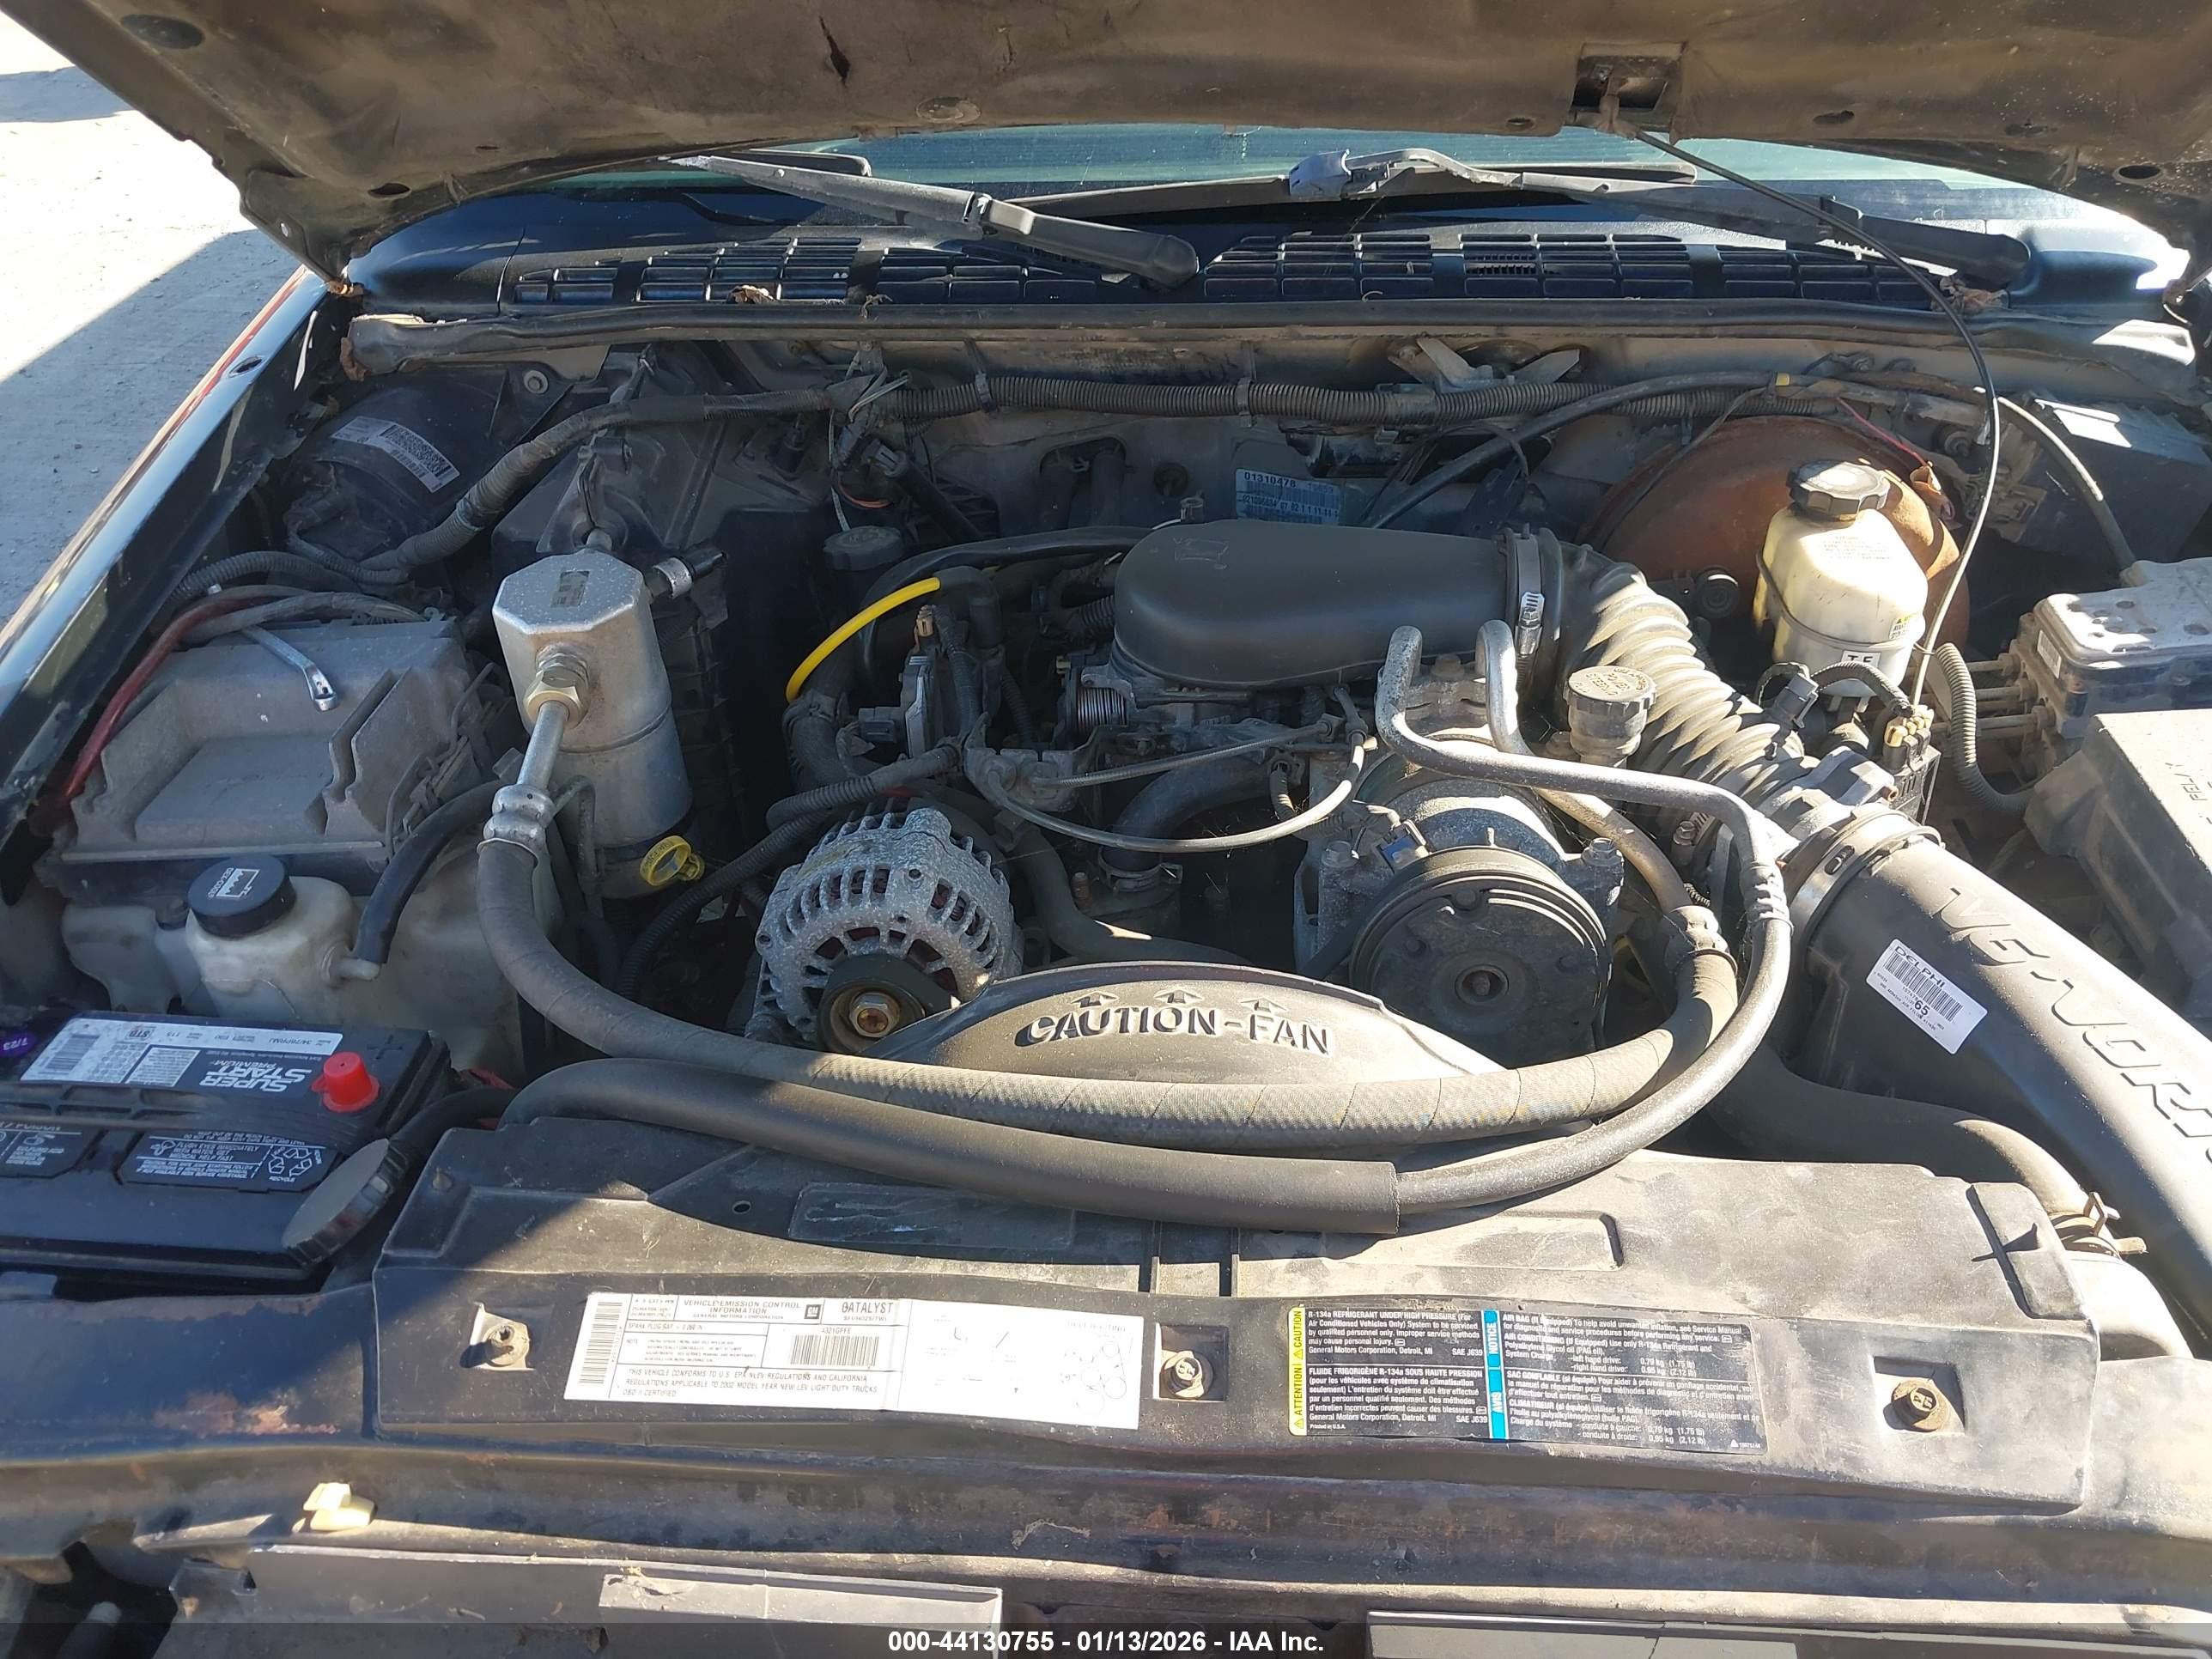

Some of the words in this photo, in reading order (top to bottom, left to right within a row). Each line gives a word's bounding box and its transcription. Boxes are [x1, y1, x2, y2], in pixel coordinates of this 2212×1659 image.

[1244, 472, 1296, 488] 01310478
[1893, 945, 1946, 988] DELPHI
[1914, 1000, 1931, 1016] 65
[199, 1076, 291, 1091] SUPER
[206, 1068, 313, 1083] START
[1293, 1310, 1302, 1347] CAUTION
[1317, 1328, 1345, 1337] qualified
[1389, 1321, 1406, 1329] Only)
[1408, 1321, 1431, 1329] System
[1487, 1323, 1498, 1353] NOTICE
[672, 1379, 708, 1388] APPLICABLE
[1293, 1367, 1303, 1415] ATTENTION
[1492, 1392, 1503, 1412] AVIS
